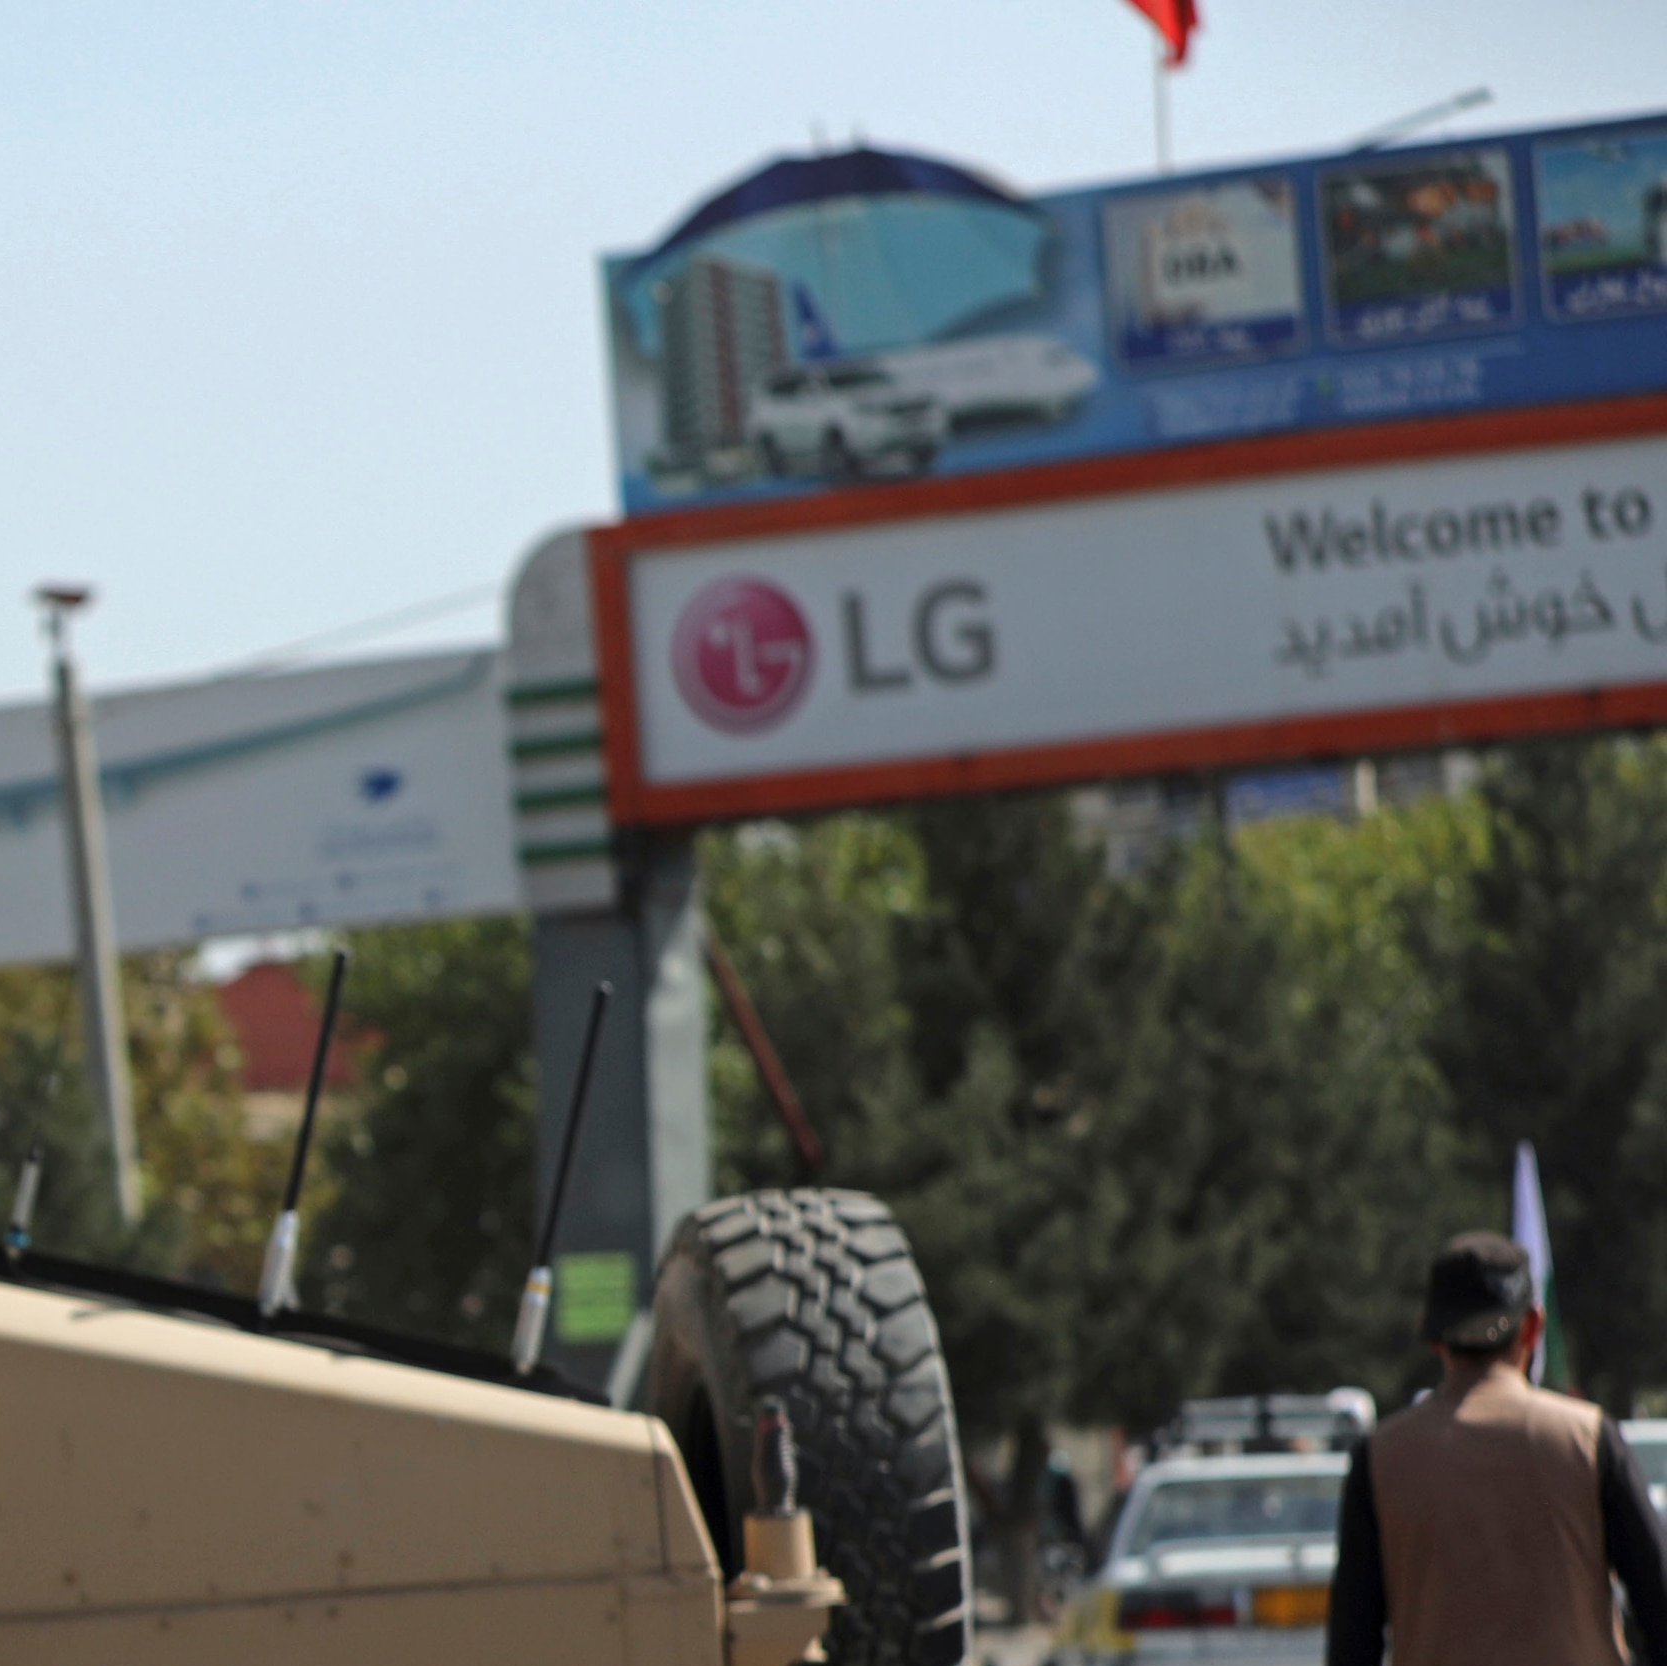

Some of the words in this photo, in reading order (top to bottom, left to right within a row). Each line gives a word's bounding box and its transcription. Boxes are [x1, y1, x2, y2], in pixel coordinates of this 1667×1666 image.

[1265, 499, 1561, 573] Welcome
[1582, 489, 1652, 541] to
[842, 577, 994, 690] LG
[1439, 568, 1614, 666] خوش
